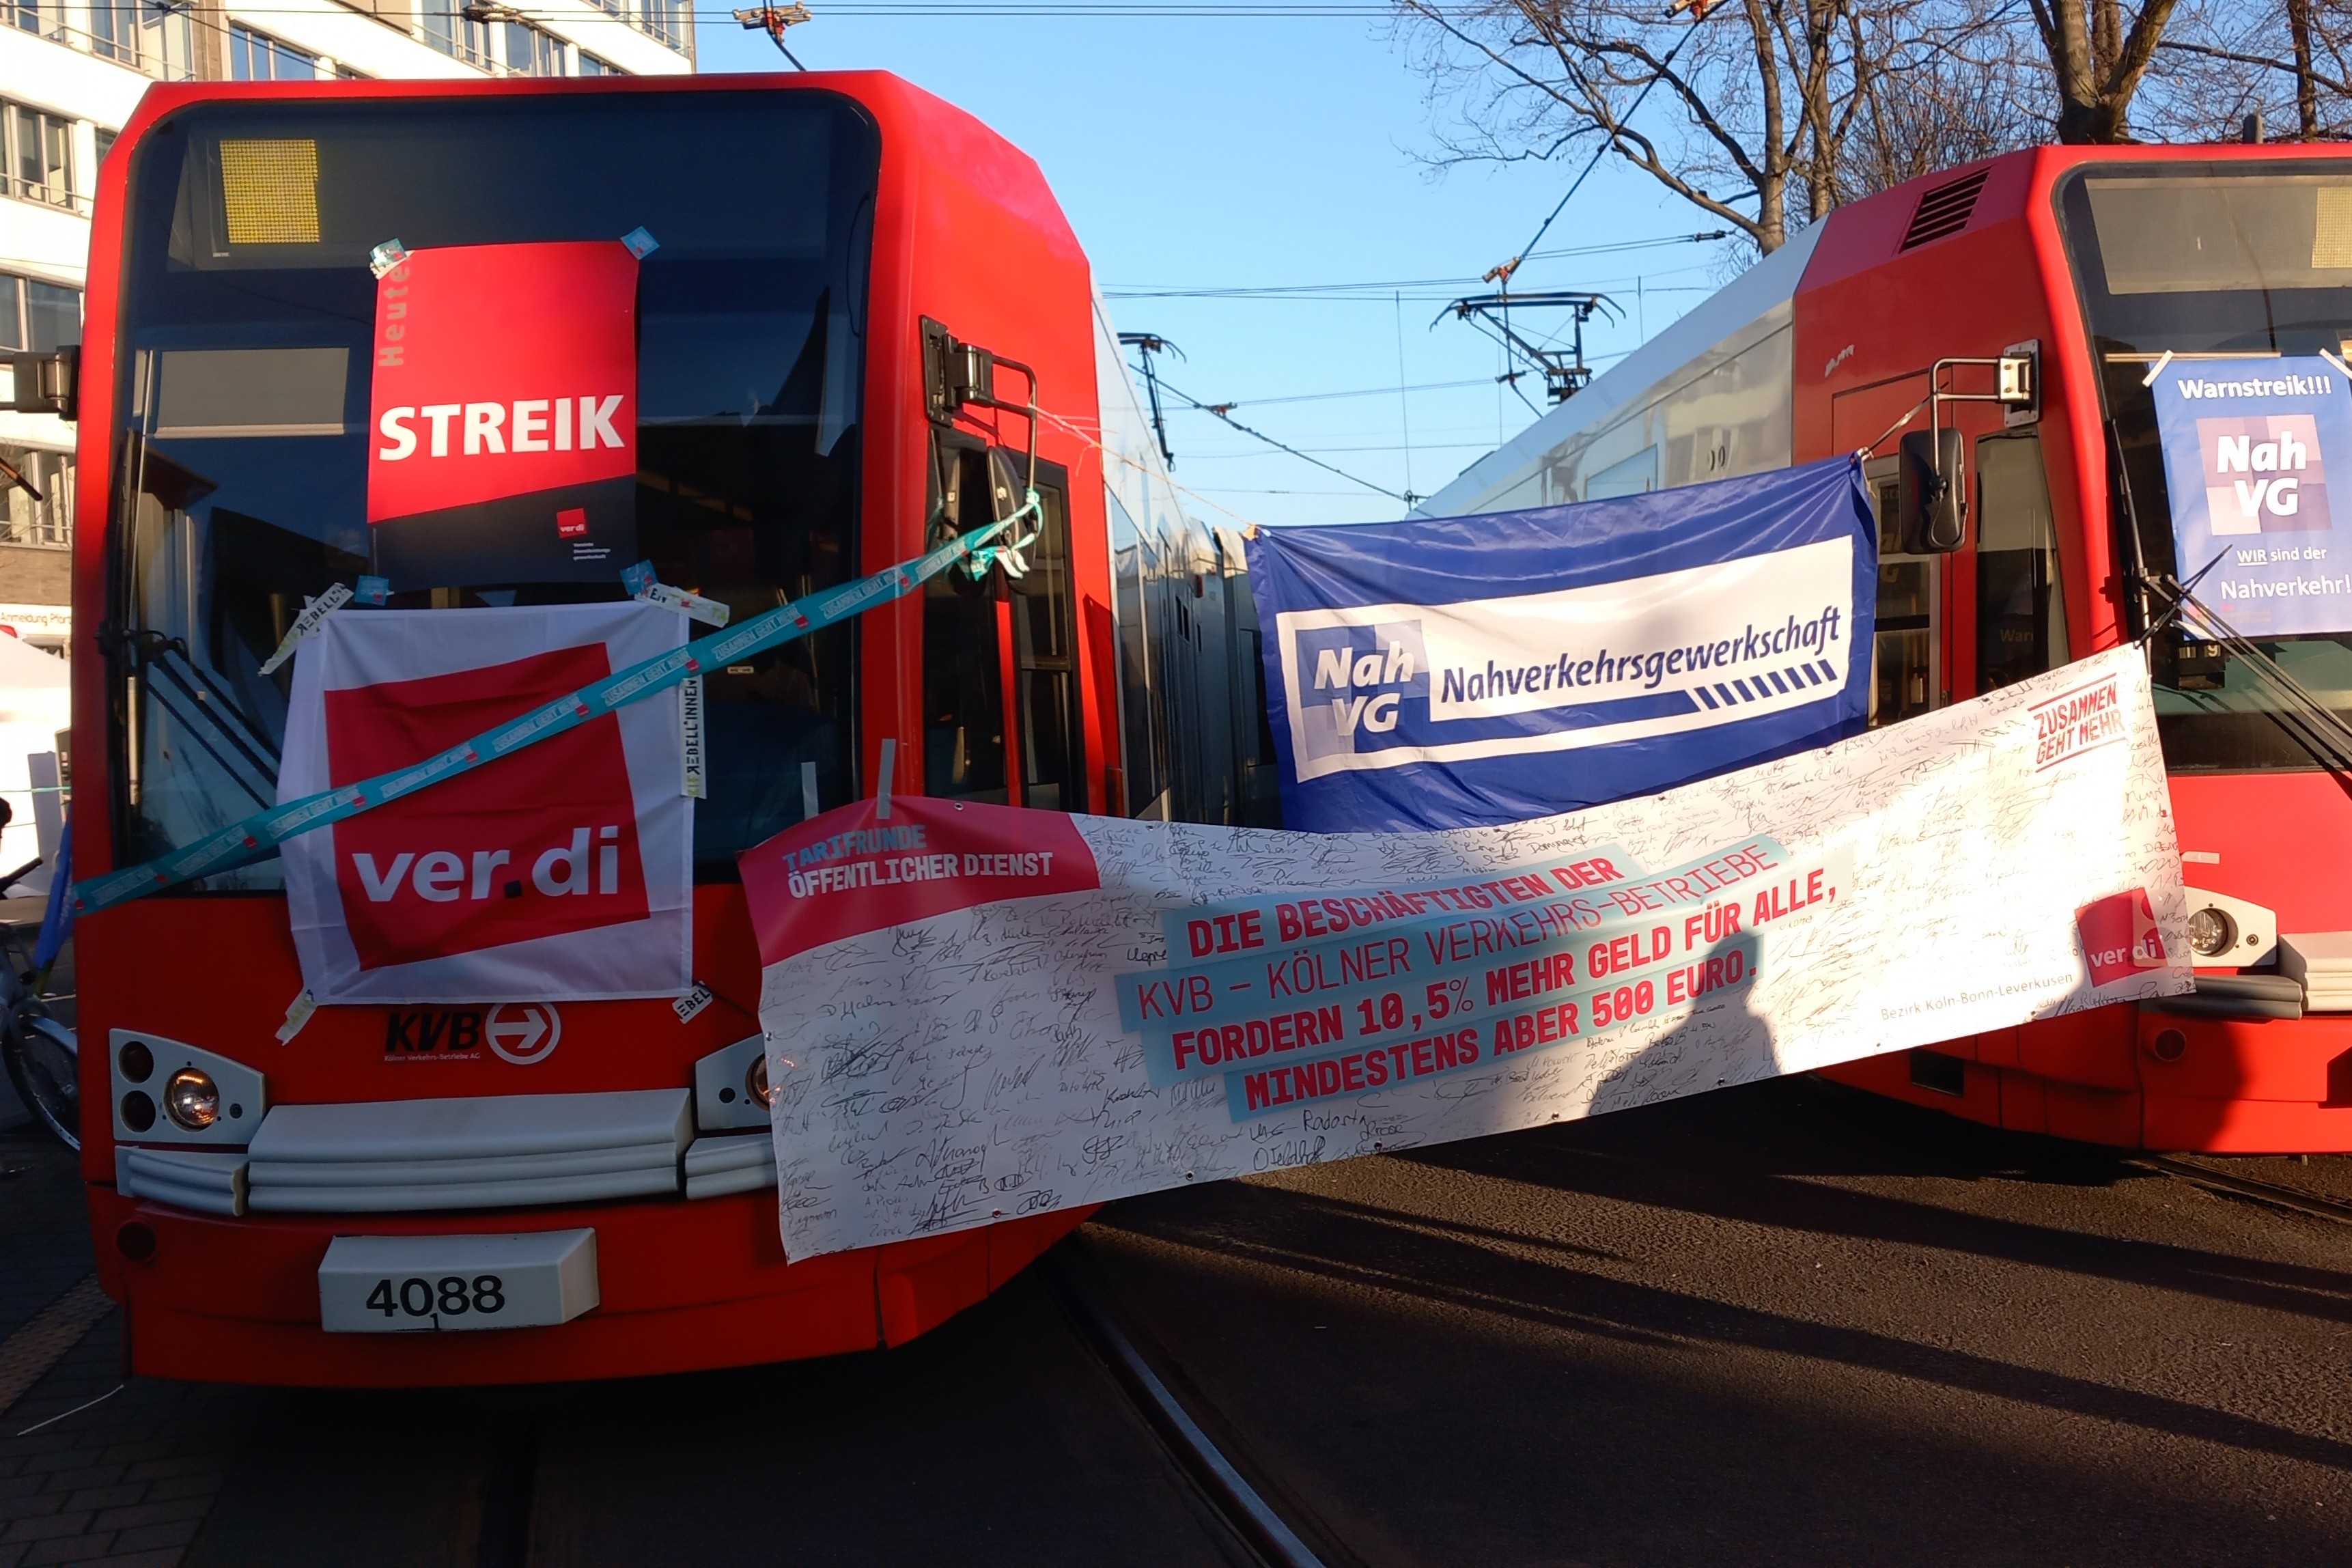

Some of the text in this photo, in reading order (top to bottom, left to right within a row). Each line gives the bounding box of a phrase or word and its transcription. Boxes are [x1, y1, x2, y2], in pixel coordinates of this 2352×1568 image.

[378, 262, 410, 366] Heute
[2177, 376, 2332, 399] Warnstreik!!!
[379, 394, 625, 461] STREIK
[2217, 430, 2306, 473] Nah
[2233, 477, 2299, 517] VG
[2237, 546, 2327, 562] WIR sind der
[2220, 574, 2352, 600] Nahverkehr!
[1313, 640, 1415, 691] Nah
[1441, 606, 1841, 704] Nahverkehrsgewerkschaft
[1330, 692, 1403, 736] VG
[2034, 682, 2117, 738] ZUSAMMEN
[2036, 708, 2127, 765] GEHT MEHR
[353, 826, 619, 902] ver.di
[783, 824, 927, 871] TARIFRUNDE
[787, 854, 960, 899] ÖFFENTLICHER
[964, 852, 1054, 877] DIENST
[1138, 974, 1214, 1020] KVB
[1267, 936, 1412, 999] KÖLNER
[1424, 844, 1778, 965] VERKEHRS-BETRIEBE
[1187, 910, 1265, 958] DIE
[1276, 873, 1554, 943] BESCHÄFTIGTEN
[1552, 858, 1625, 891] DER
[1172, 868, 1836, 1070] FORDERN 10,5% MEHR GELD FÜR ALLE,
[2090, 938, 2157, 968] ver.di
[1881, 1002, 1922, 1021] Bezirk
[1925, 971, 2074, 1011] Köln-Bonn-Leverkusen
[385, 1011, 482, 1052] KVB
[1244, 1028, 1480, 1112] MINDESTENS
[1494, 1002, 1579, 1056] ABER
[1593, 981, 1654, 1028] 500
[1666, 949, 1758, 1007] EURO.
[366, 1275, 505, 1317] 4088
